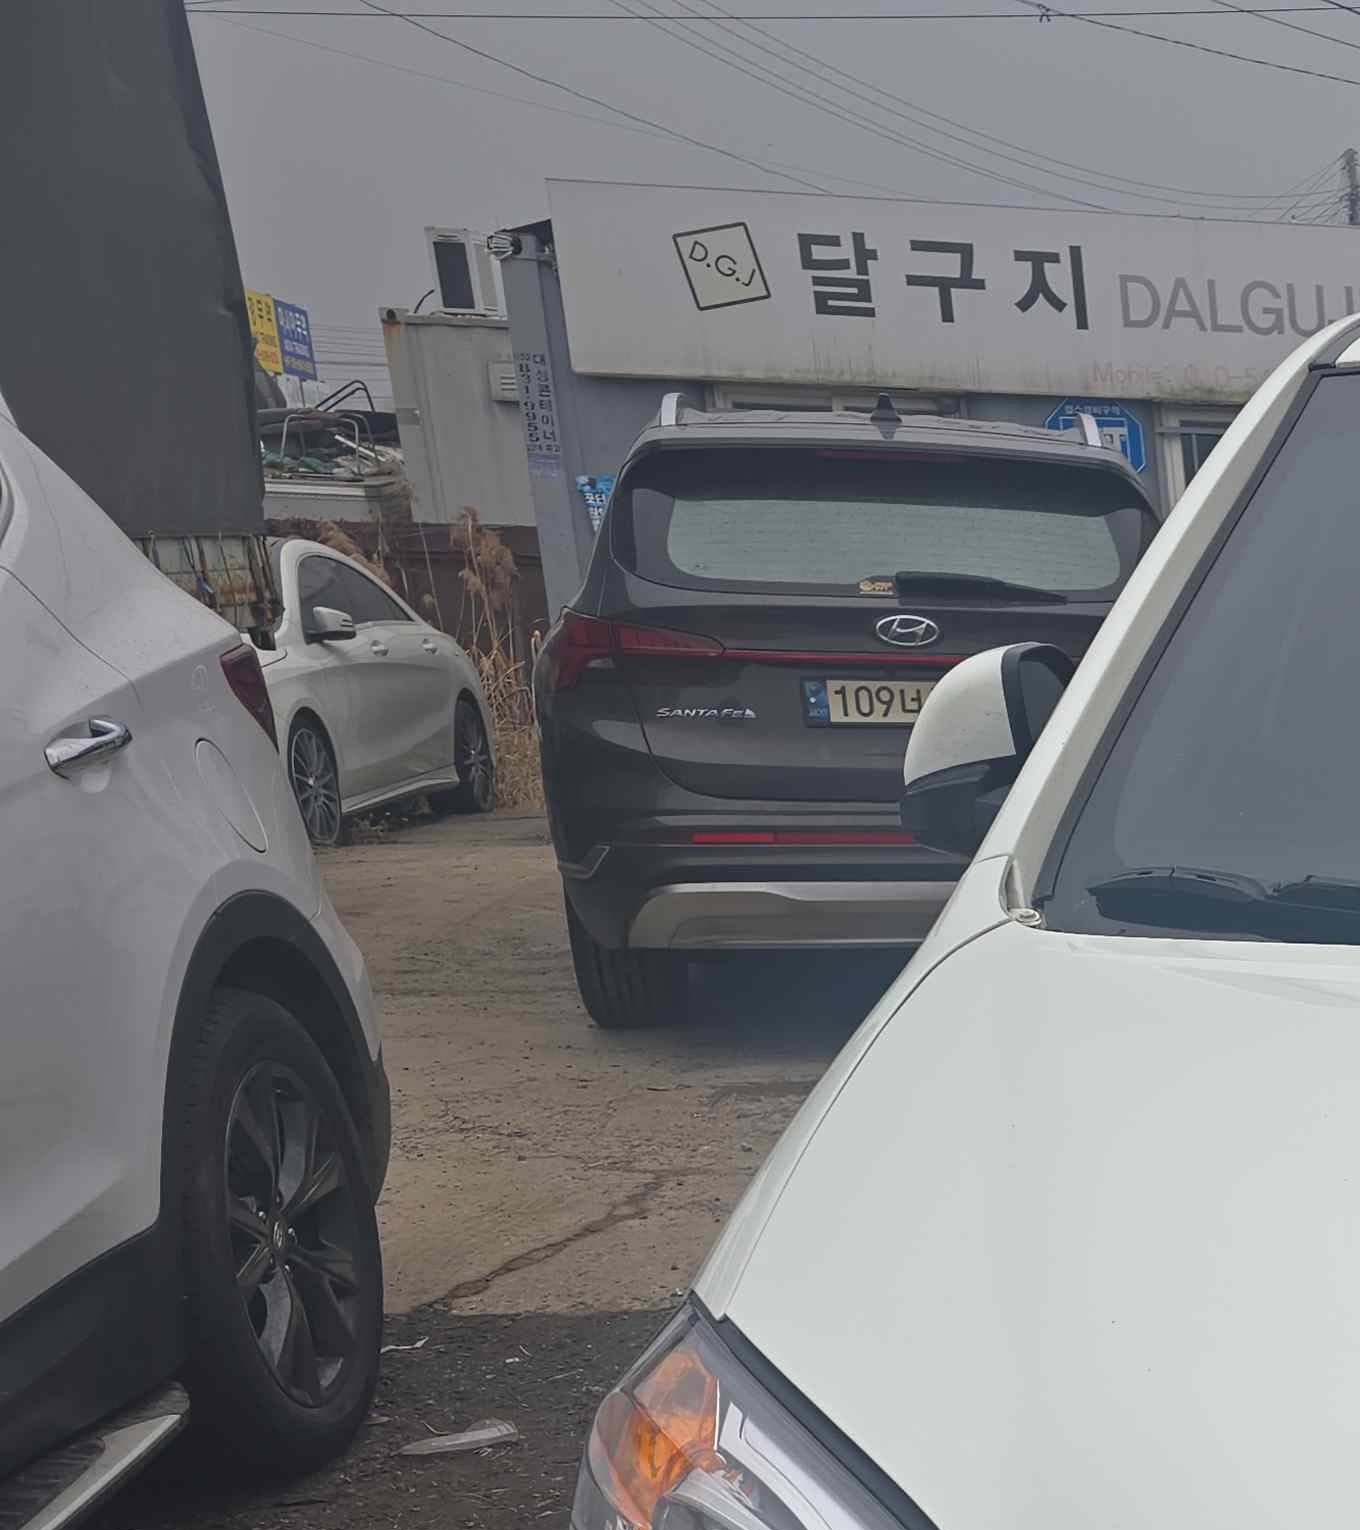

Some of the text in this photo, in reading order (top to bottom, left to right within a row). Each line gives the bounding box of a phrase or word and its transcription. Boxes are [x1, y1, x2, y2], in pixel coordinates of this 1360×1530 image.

[688, 240, 756, 287] D.G.J
[797, 231, 1089, 331] 달구지
[656, 707, 720, 718] SANTA
